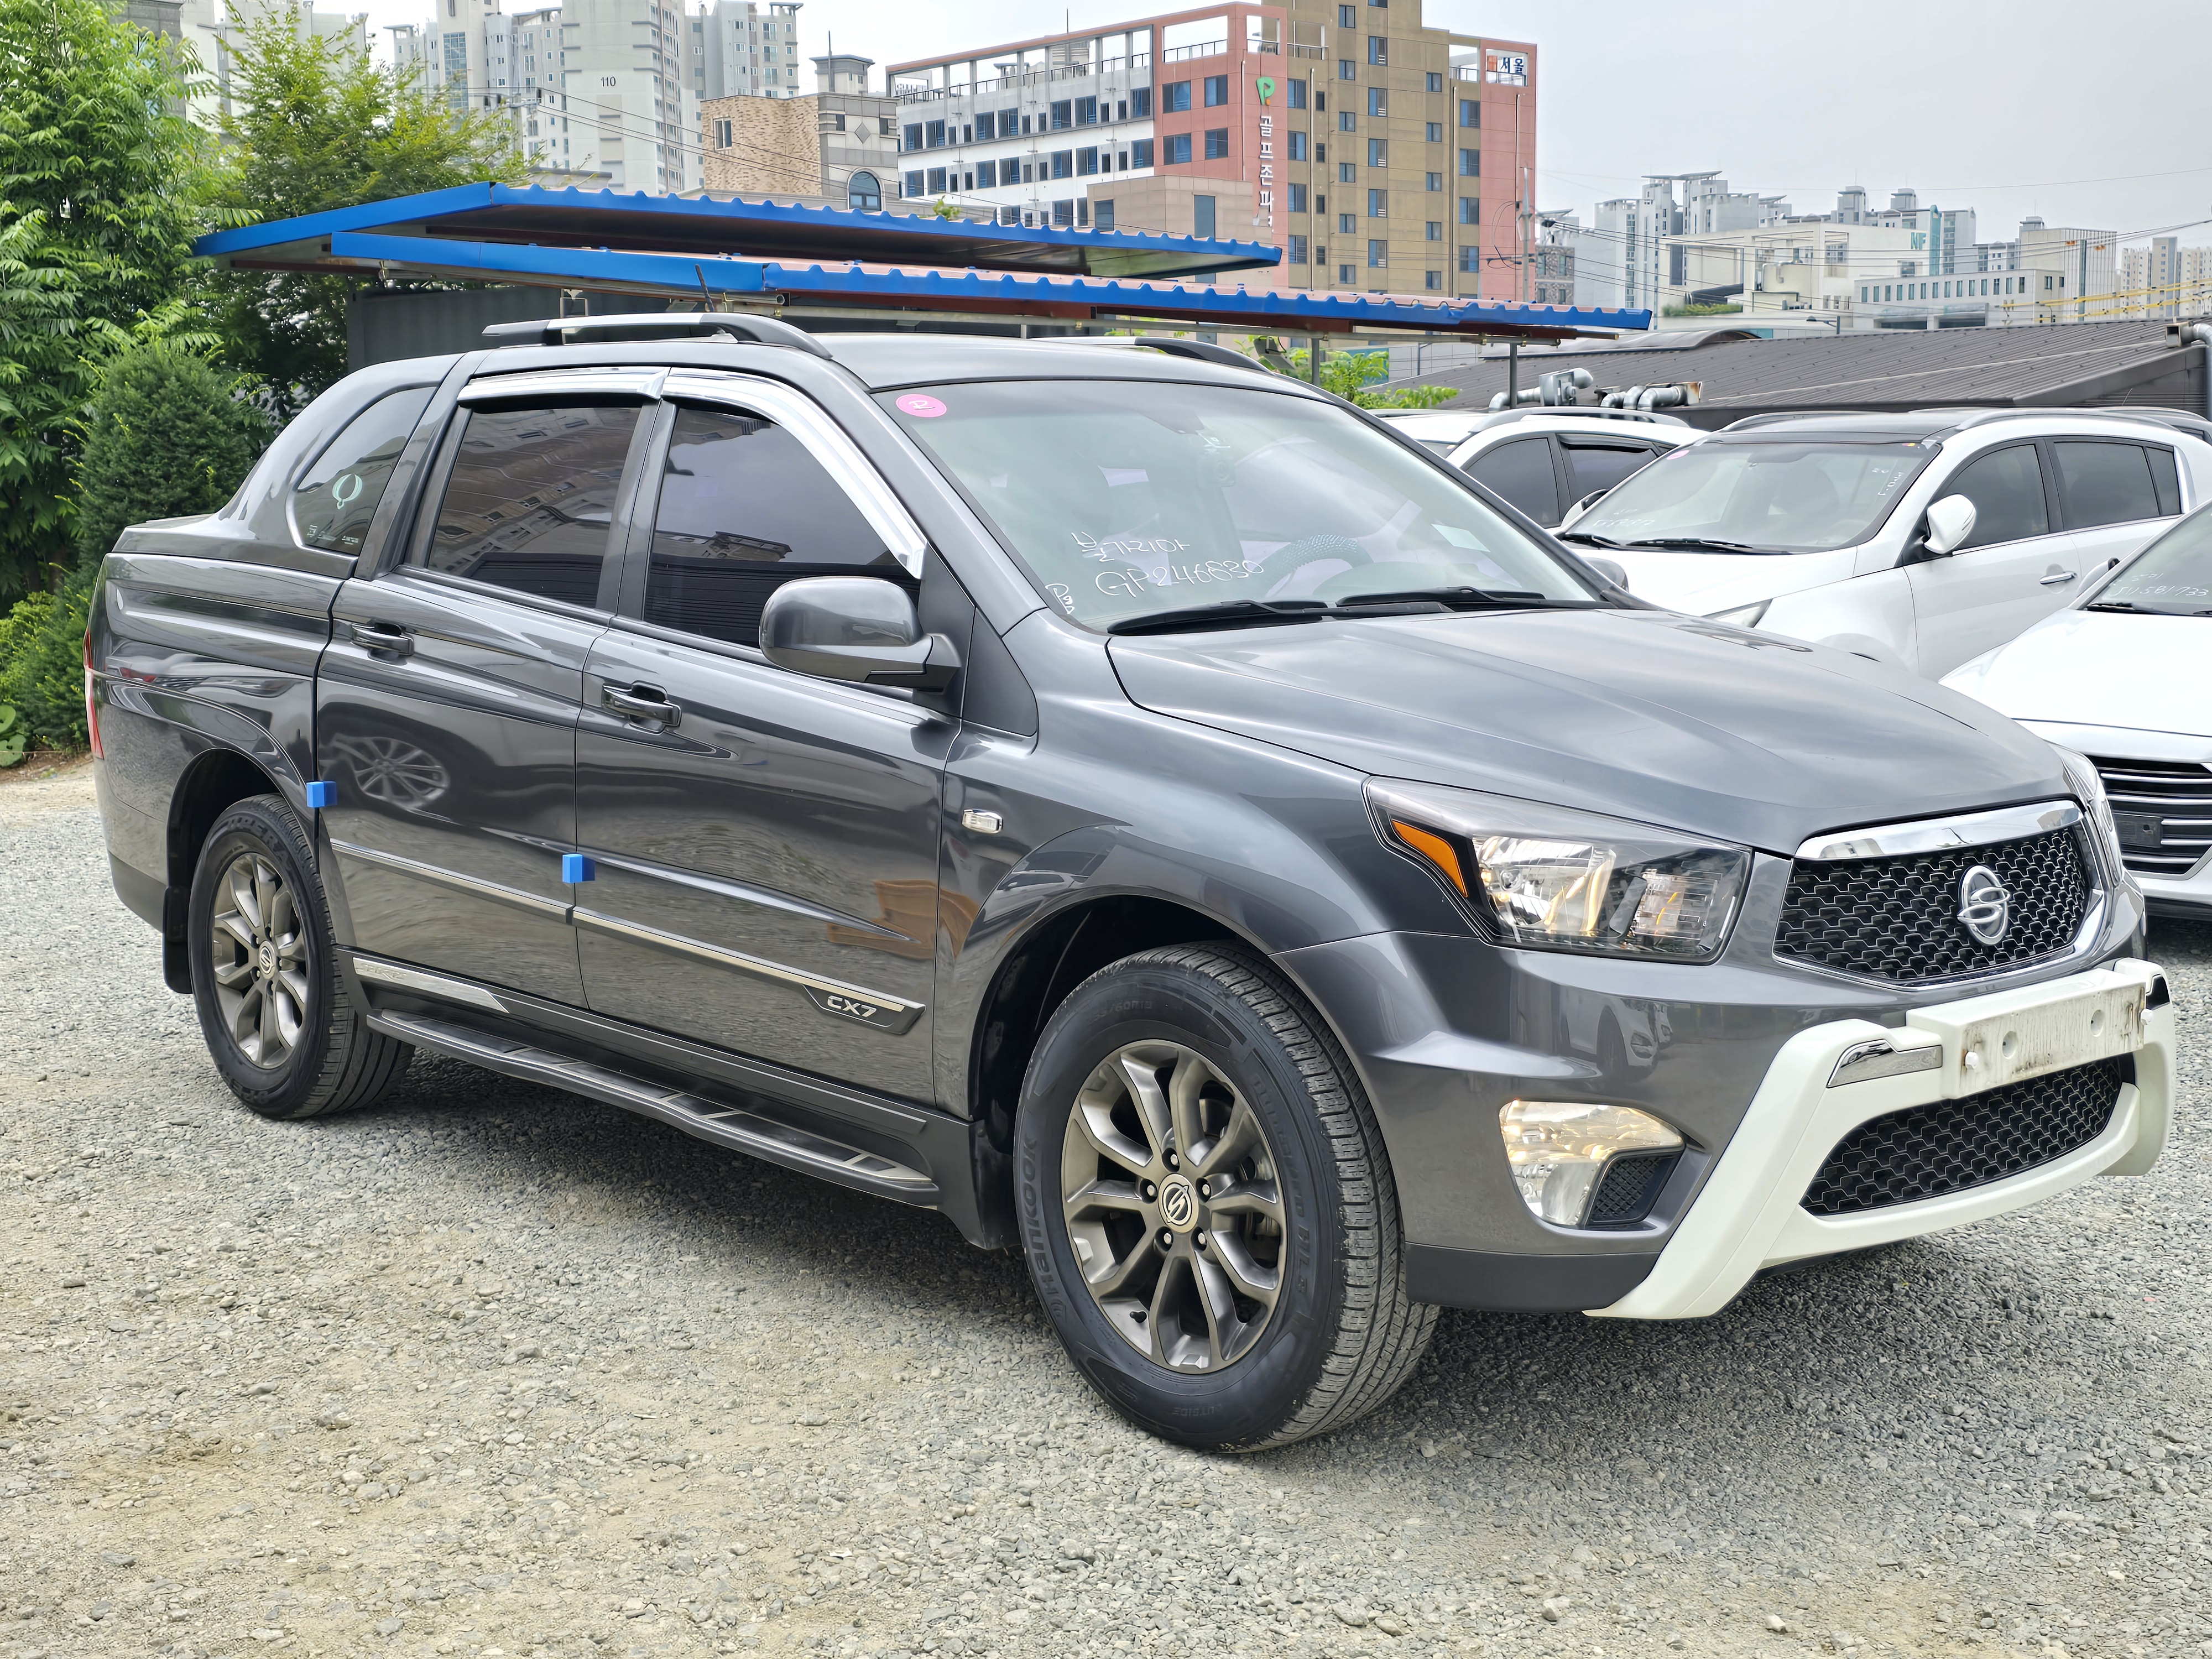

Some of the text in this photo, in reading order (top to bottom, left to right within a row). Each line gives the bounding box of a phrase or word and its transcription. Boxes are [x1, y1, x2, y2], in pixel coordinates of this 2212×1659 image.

[601, 76, 616, 87] 110
[1259, 115, 1274, 227] 골프존파
[827, 995, 877, 1018] CX7
